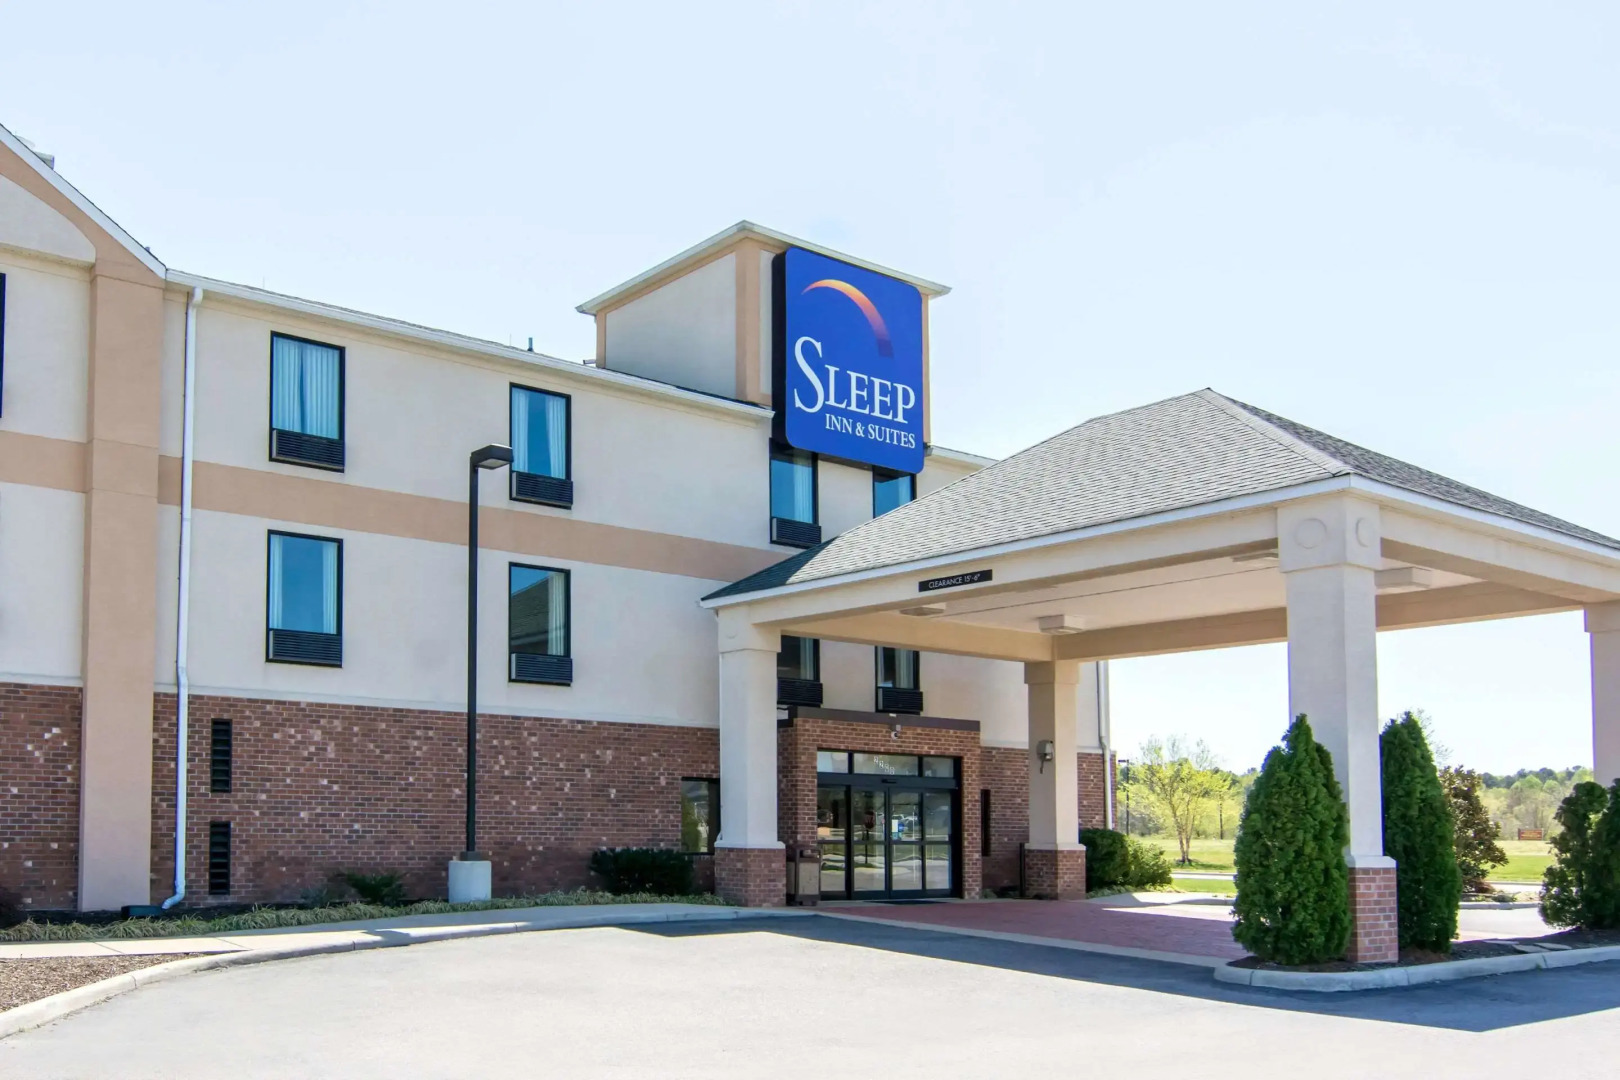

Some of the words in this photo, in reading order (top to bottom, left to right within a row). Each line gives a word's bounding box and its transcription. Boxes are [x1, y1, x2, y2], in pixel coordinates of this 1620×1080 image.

[794, 336, 916, 424] SLEEP
[825, 413, 853, 433] INN
[855, 422, 865, 437] &
[868, 423, 916, 449] SUITES
[928, 576, 963, 589] CLEARANCE
